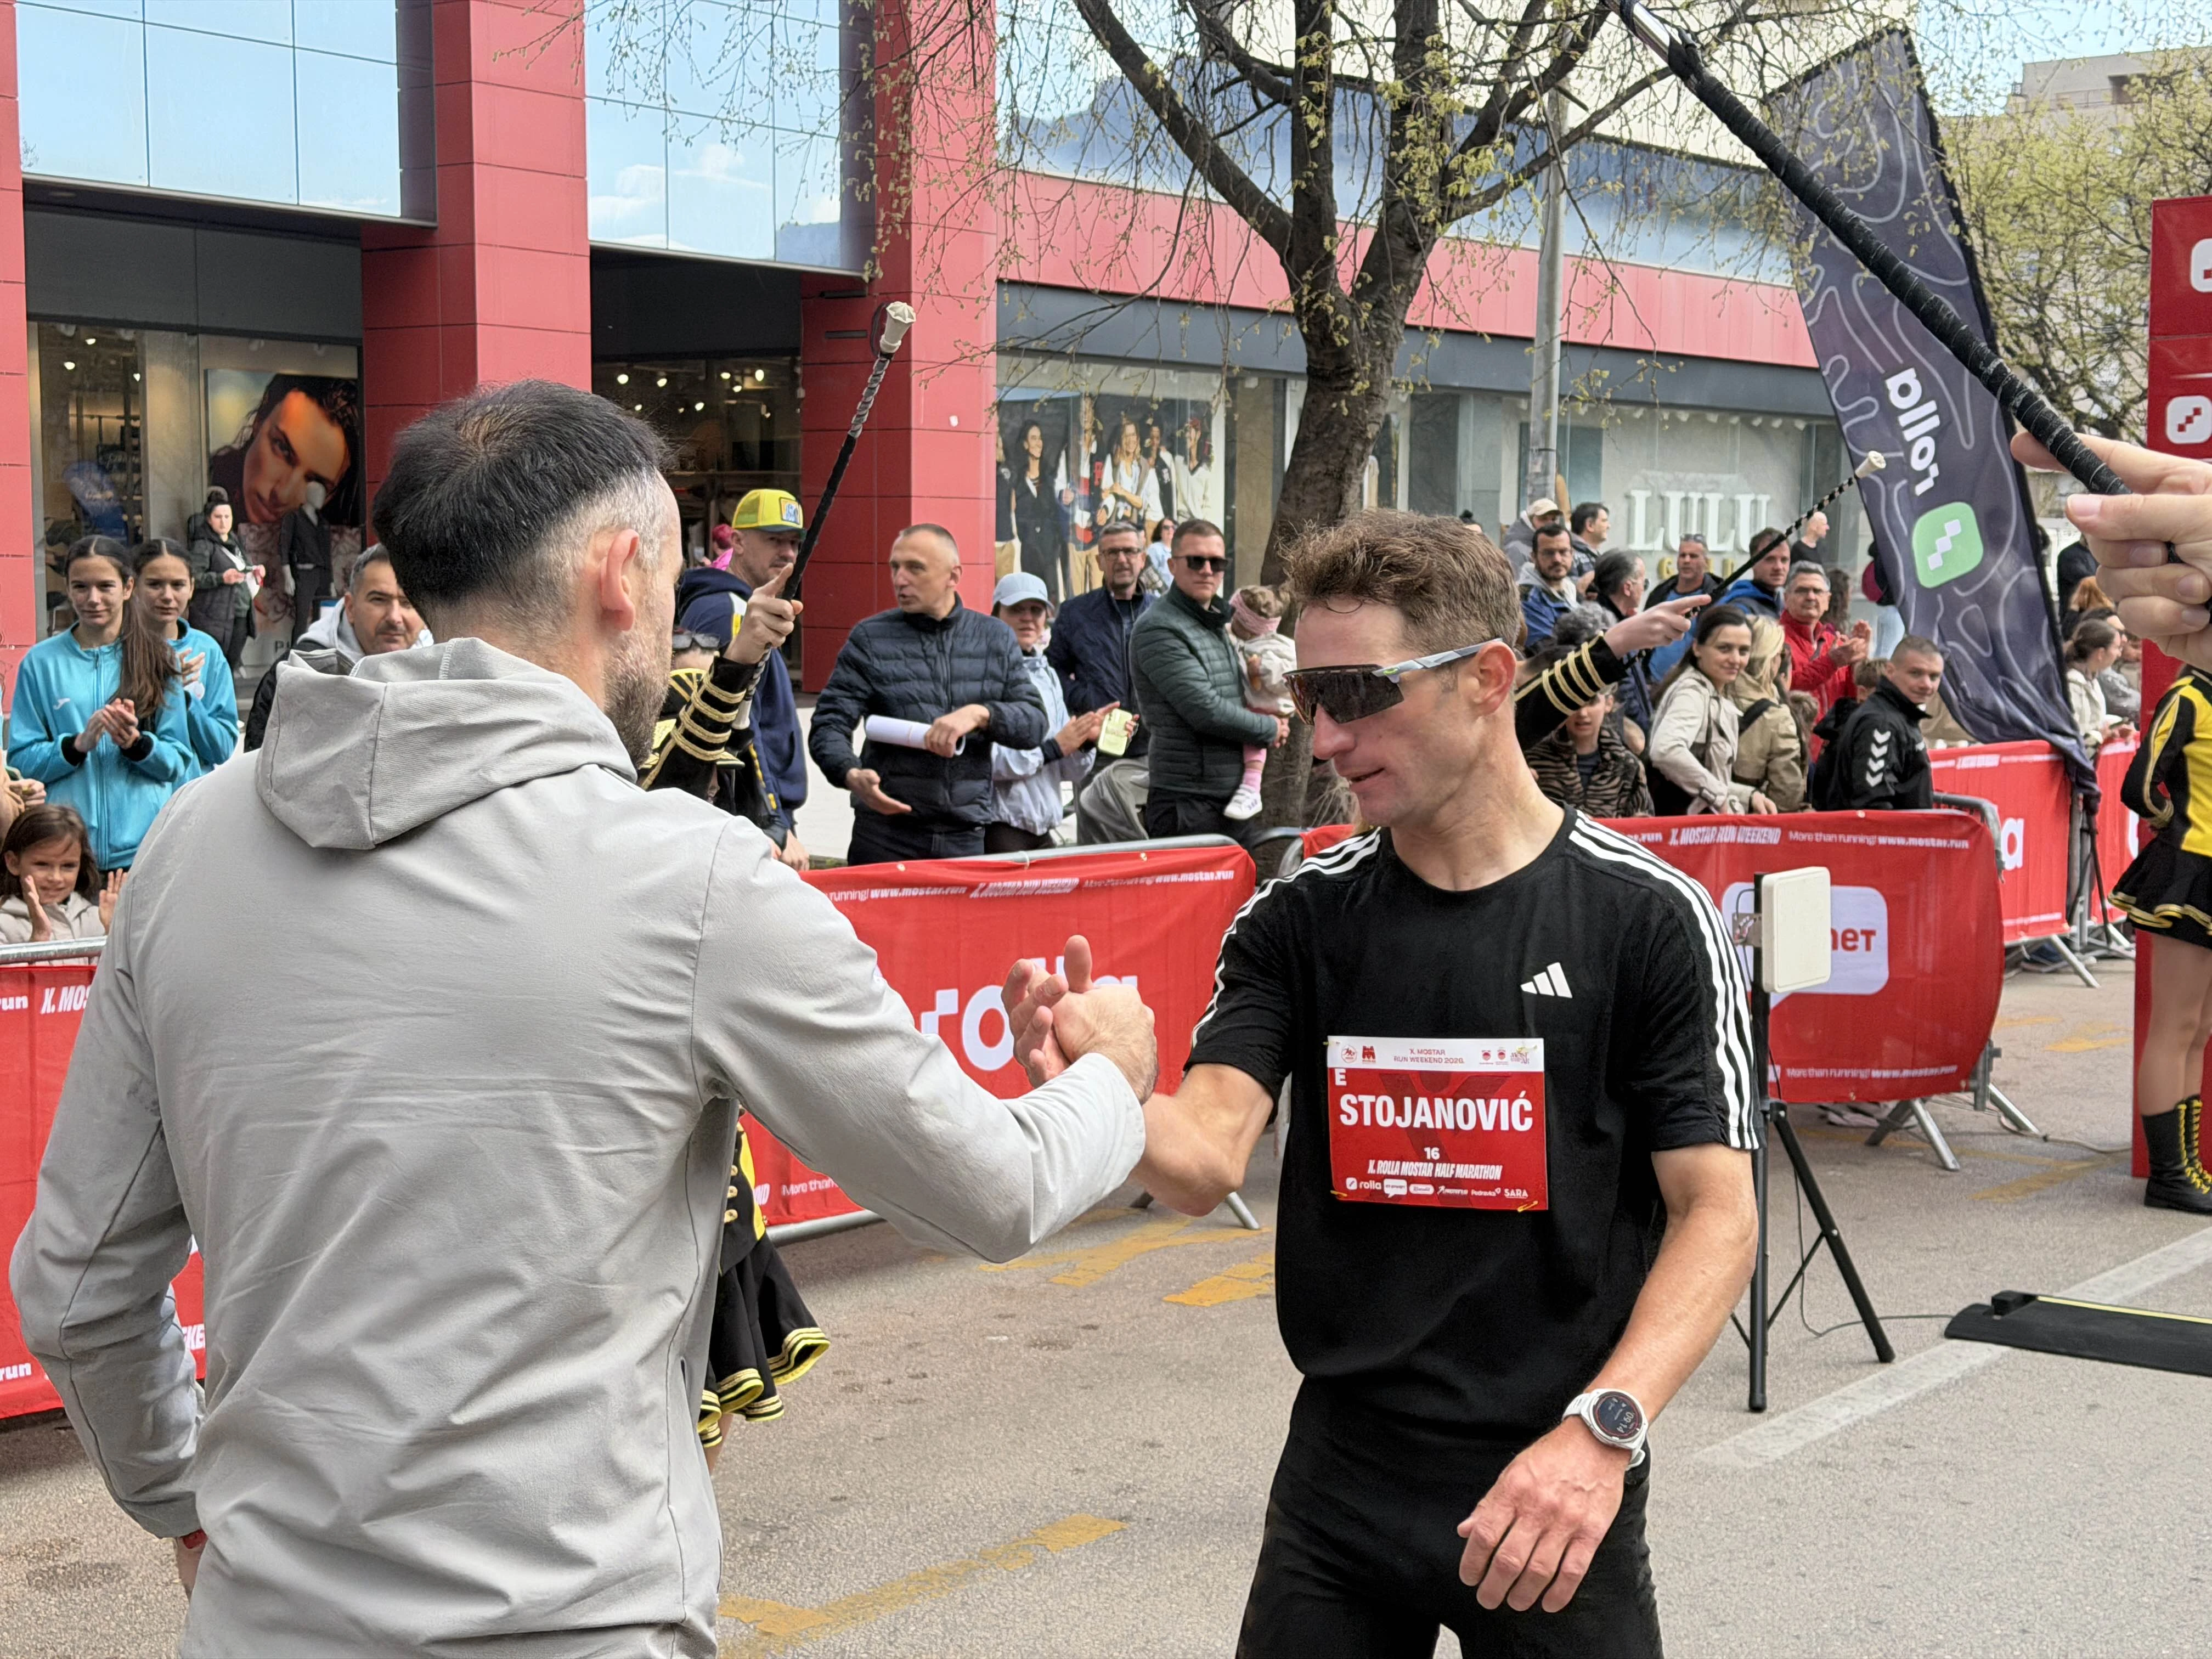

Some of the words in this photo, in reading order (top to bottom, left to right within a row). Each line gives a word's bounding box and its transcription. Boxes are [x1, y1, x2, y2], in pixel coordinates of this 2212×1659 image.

[1885, 368, 1940, 496] rolla
[1627, 489, 1771, 552] LULU
[1736, 825, 1781, 845] WEEKEND
[1788, 831, 1813, 842] More
[1815, 832, 1837, 843] than
[1878, 835, 1969, 849] www.mostar.run
[870, 886, 967, 899] www.mostar.run
[40, 988, 57, 1014] X.
[1335, 1069, 1347, 1086] E
[1340, 1090, 1533, 1132] STOJANOVIĆ
[1424, 1147, 1441, 1160] 16
[1367, 1159, 1376, 1175] X.
[1376, 1160, 1401, 1176] ROLLA
[1400, 1161, 1434, 1177] MOSTAR
[1434, 1163, 1455, 1178] HALF
[1455, 1164, 1503, 1181] MARATHON
[782, 1184, 808, 1197] More
[1359, 1180, 1382, 1190] rolla
[1504, 1188, 1528, 1198] SARA
